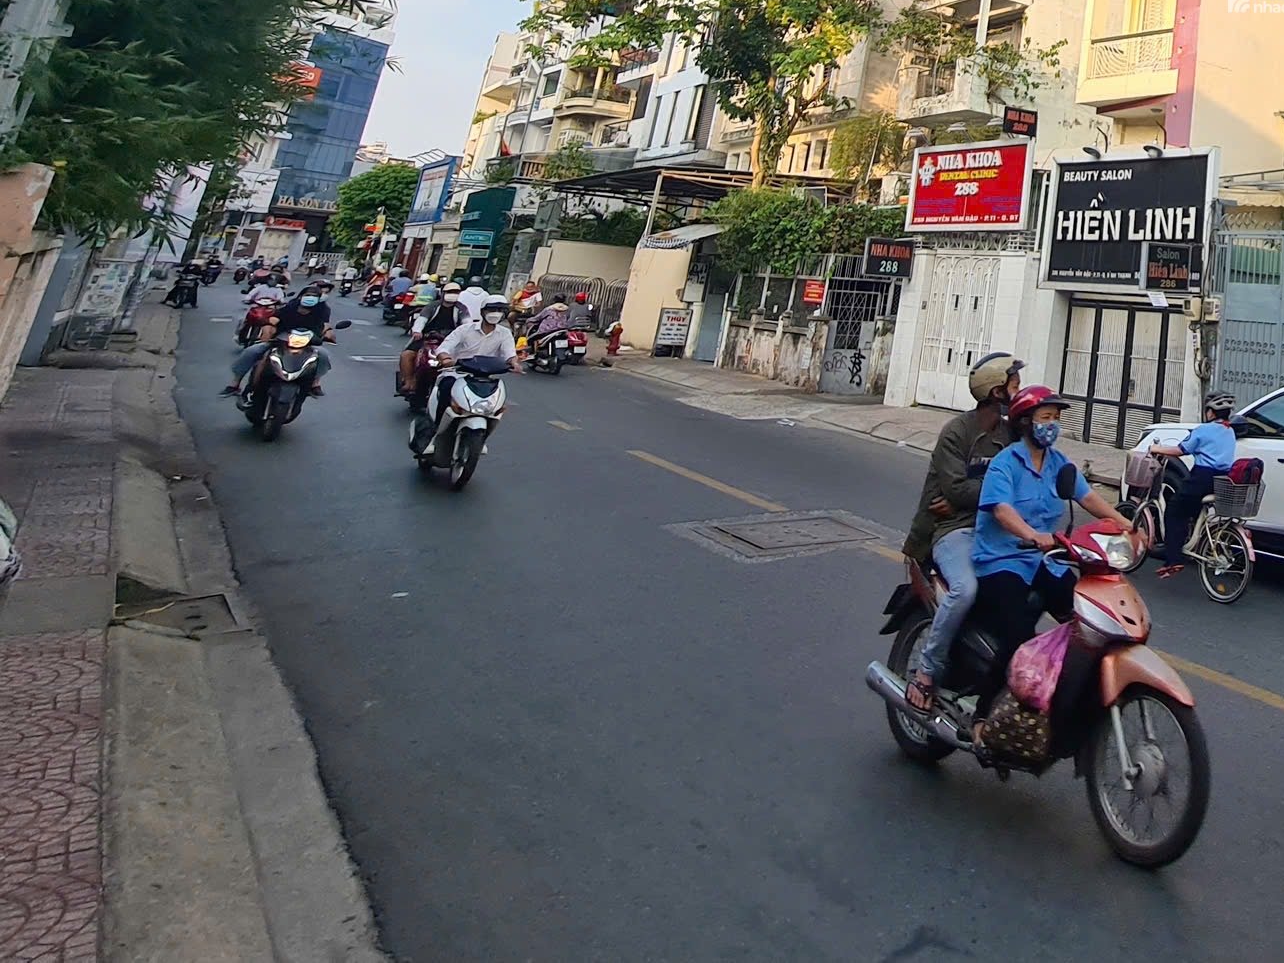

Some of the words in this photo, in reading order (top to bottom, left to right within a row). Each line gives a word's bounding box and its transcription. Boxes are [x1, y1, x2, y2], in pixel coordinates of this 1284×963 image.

[936, 153, 965, 170] NHA
[965, 150, 1003, 168] KHOA
[1063, 170, 1099, 182] BEAUTY
[1100, 169, 1133, 181] SALON
[1056, 192, 1122, 241] HIỀN
[1128, 206, 1197, 241] LINH
[871, 243, 888, 257] NHA
[889, 245, 911, 258] KHOA
[1156, 247, 1180, 260] Salon
[879, 260, 899, 274] 288
[1160, 279, 1177, 287] 286
